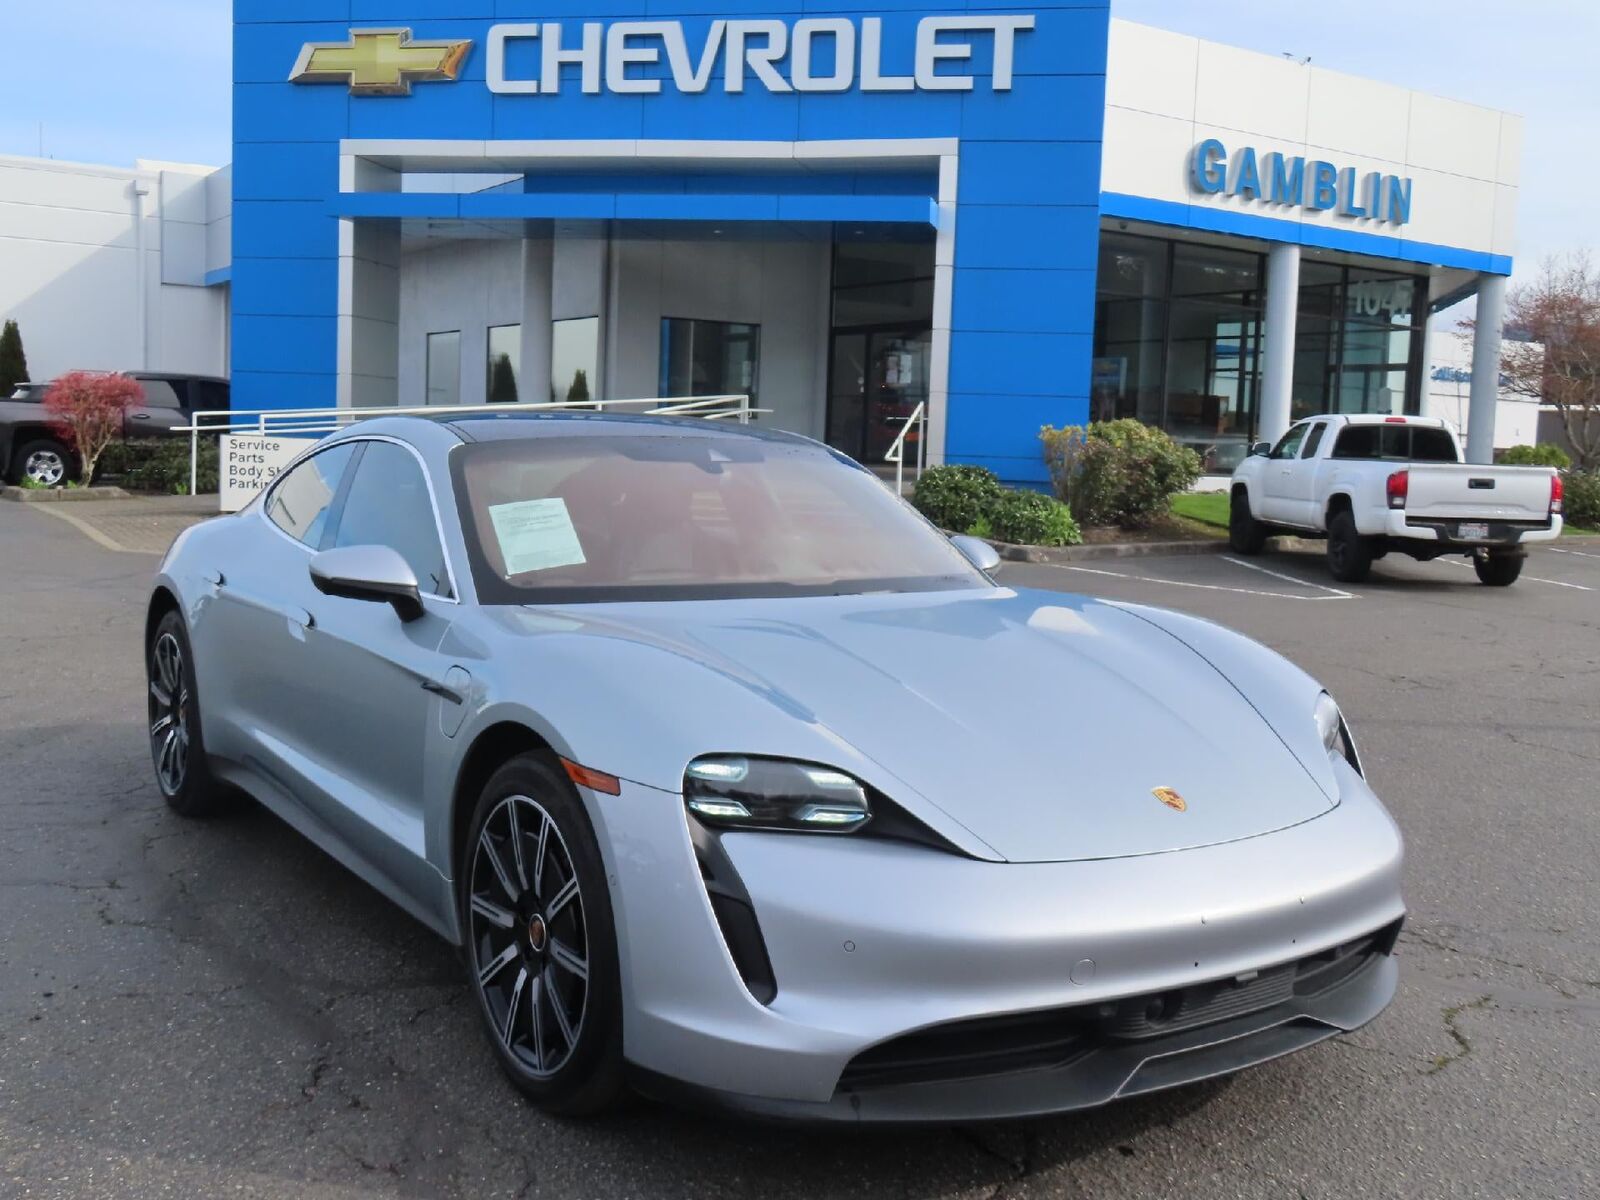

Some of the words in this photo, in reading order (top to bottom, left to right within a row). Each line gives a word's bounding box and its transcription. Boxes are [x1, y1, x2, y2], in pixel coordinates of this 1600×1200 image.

[486, 14, 1036, 94] CHEVROLET
[1190, 138, 1412, 225] GAMBLIN
[230, 438, 280, 451] Service
[229, 452, 265, 463] Parts
[229, 465, 263, 478] Body
